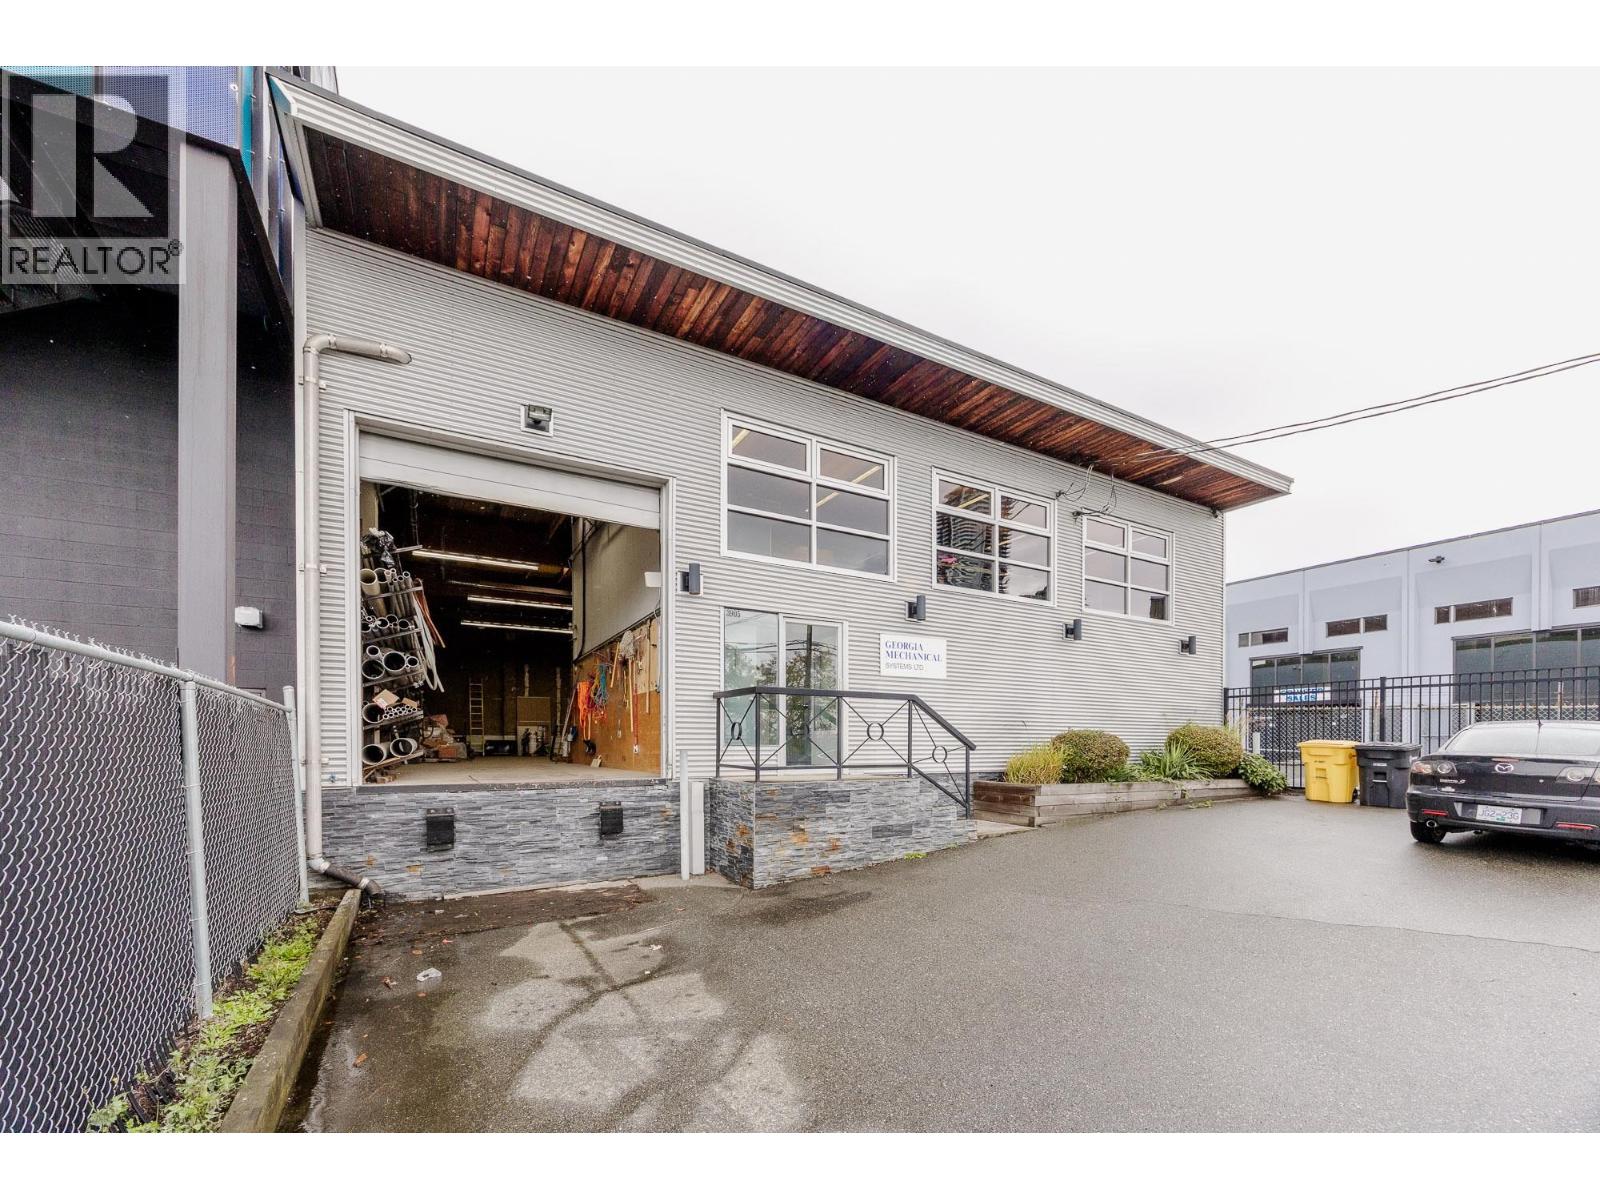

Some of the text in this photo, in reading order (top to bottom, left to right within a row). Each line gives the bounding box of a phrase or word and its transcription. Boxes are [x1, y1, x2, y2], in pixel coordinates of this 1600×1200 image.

[885, 640, 923, 651] GEORGIA
[886, 650, 942, 662] MECHANICAL
[885, 662, 912, 671] SYSTEMS
